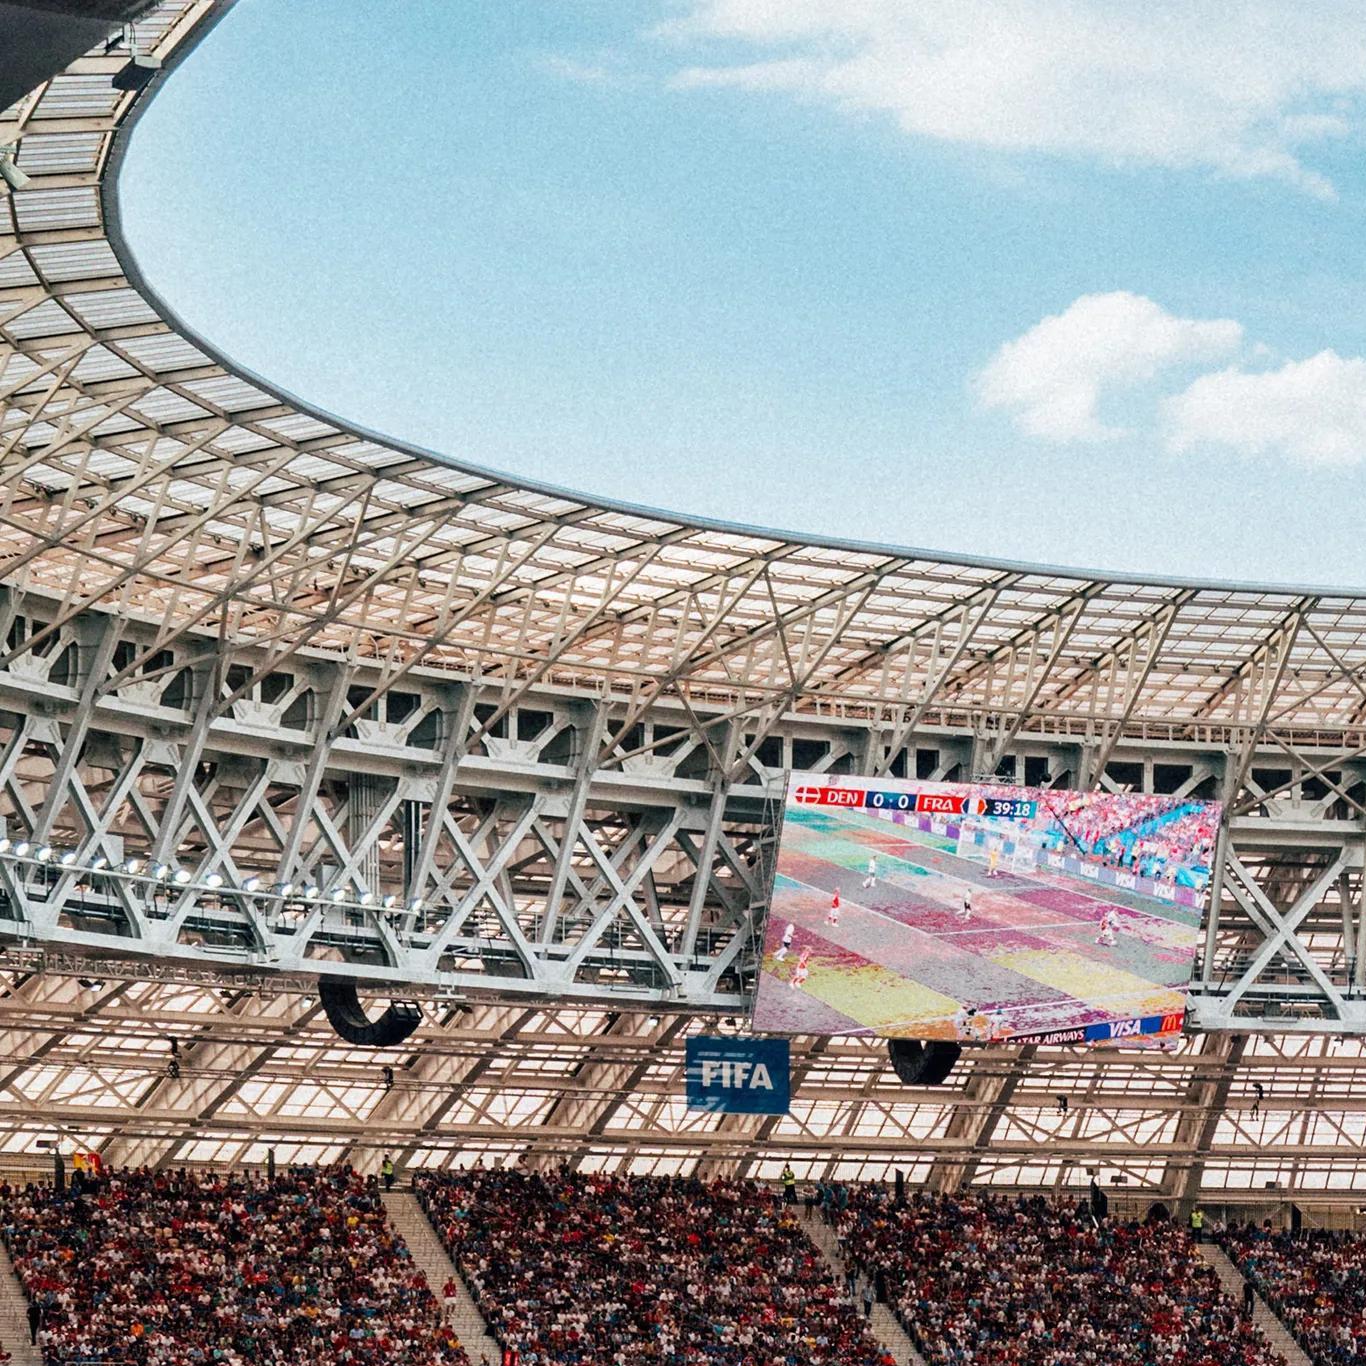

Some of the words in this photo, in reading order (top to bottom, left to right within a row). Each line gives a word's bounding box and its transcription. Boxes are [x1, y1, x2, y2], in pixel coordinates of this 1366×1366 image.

[827, 790, 858, 804] DEN
[873, 793, 883, 807] 0
[898, 795, 908, 808] 0
[923, 797, 954, 811] FRA
[993, 801, 1031, 816] 39:18
[1043, 1030, 1085, 1044] AIRWAYS
[1109, 1020, 1141, 1037] VISA
[702, 1060, 774, 1090] FIFA
